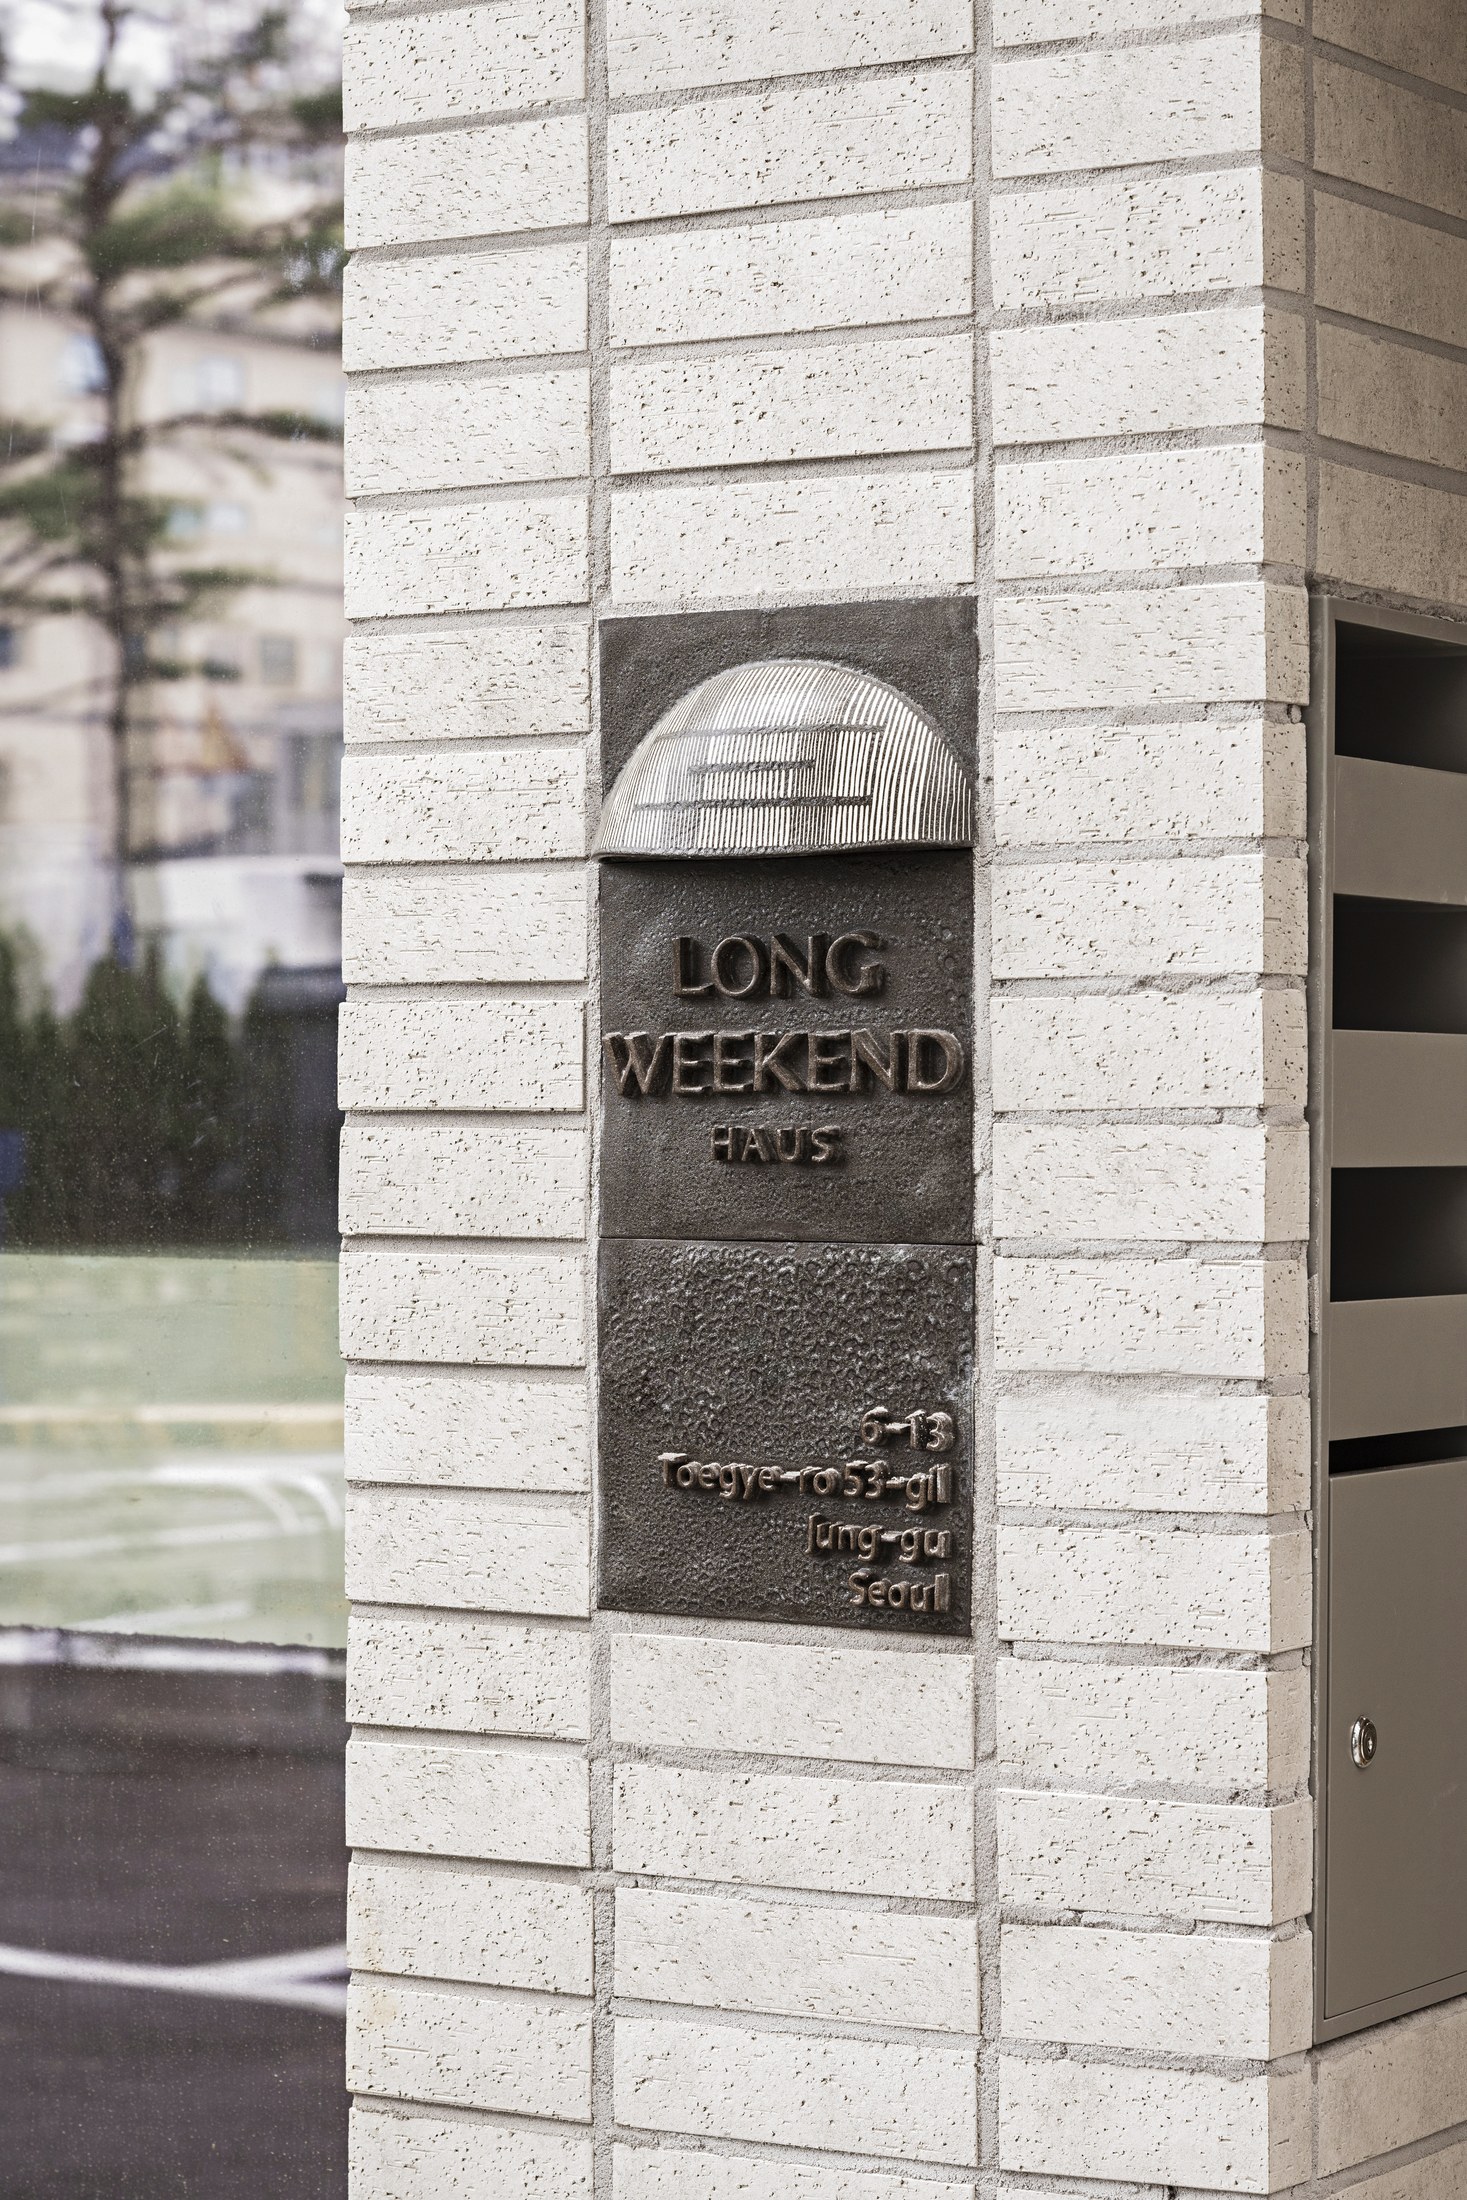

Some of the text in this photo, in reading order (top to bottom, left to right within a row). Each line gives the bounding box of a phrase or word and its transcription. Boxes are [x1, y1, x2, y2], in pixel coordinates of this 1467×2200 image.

[672, 931, 885, 999] LONG
[601, 1028, 965, 1095] WEEKEND
[710, 1124, 841, 1163] HAUS
[860, 1406, 953, 1450] 6-13
[805, 1513, 950, 1562] Jung-gu
[850, 1569, 950, 1612] Seoul
